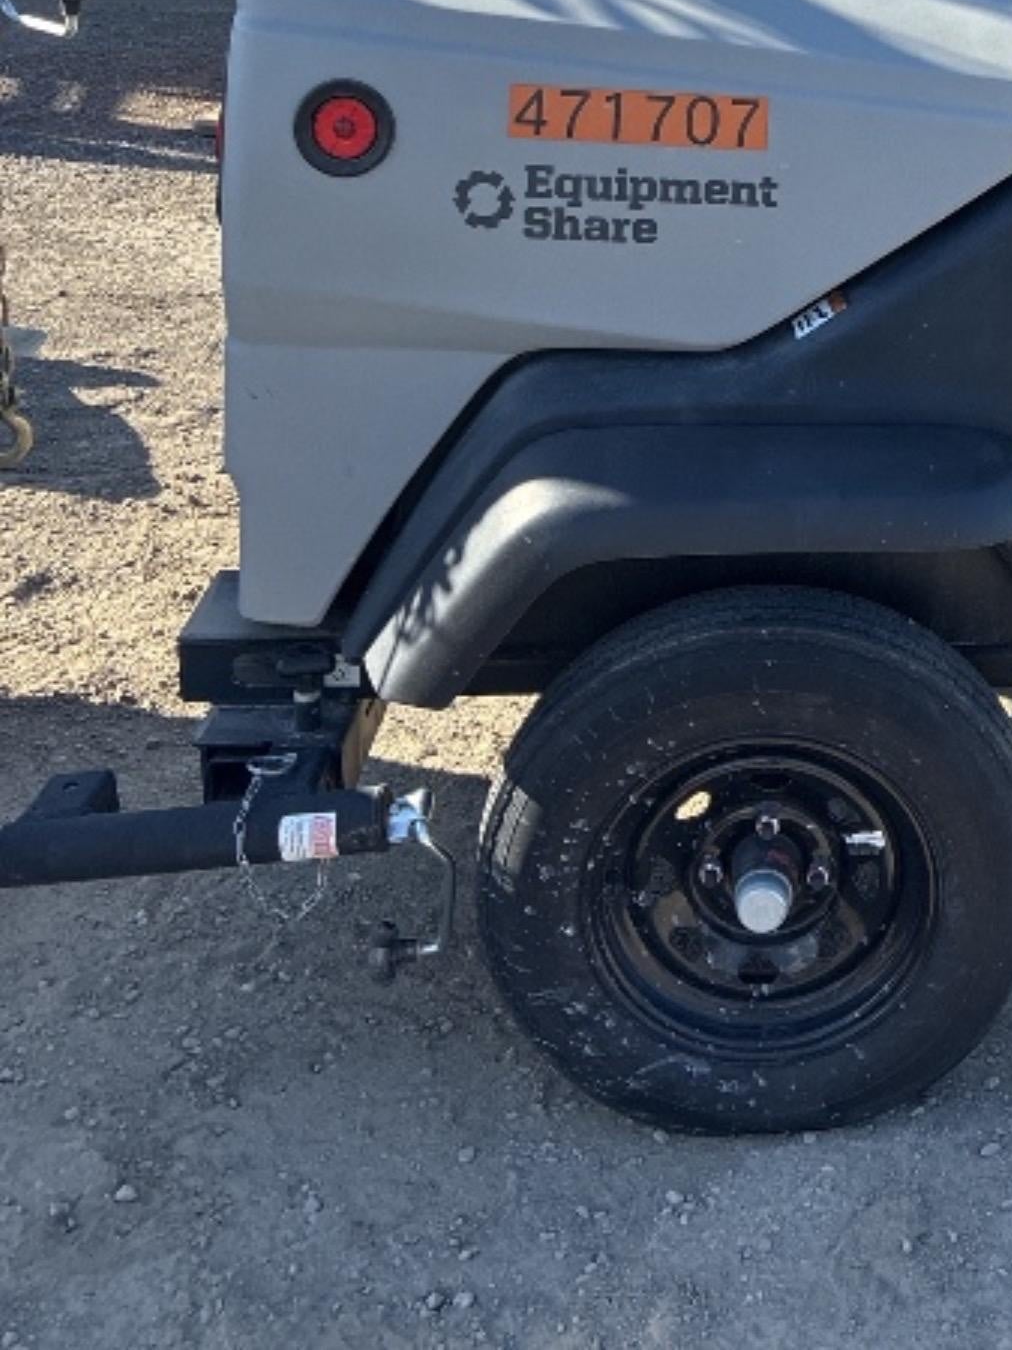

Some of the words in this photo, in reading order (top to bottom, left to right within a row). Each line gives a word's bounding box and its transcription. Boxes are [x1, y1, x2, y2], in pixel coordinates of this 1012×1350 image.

[514, 89, 760, 148] 471707
[524, 164, 779, 212] Equipment
[524, 207, 658, 244] Share
